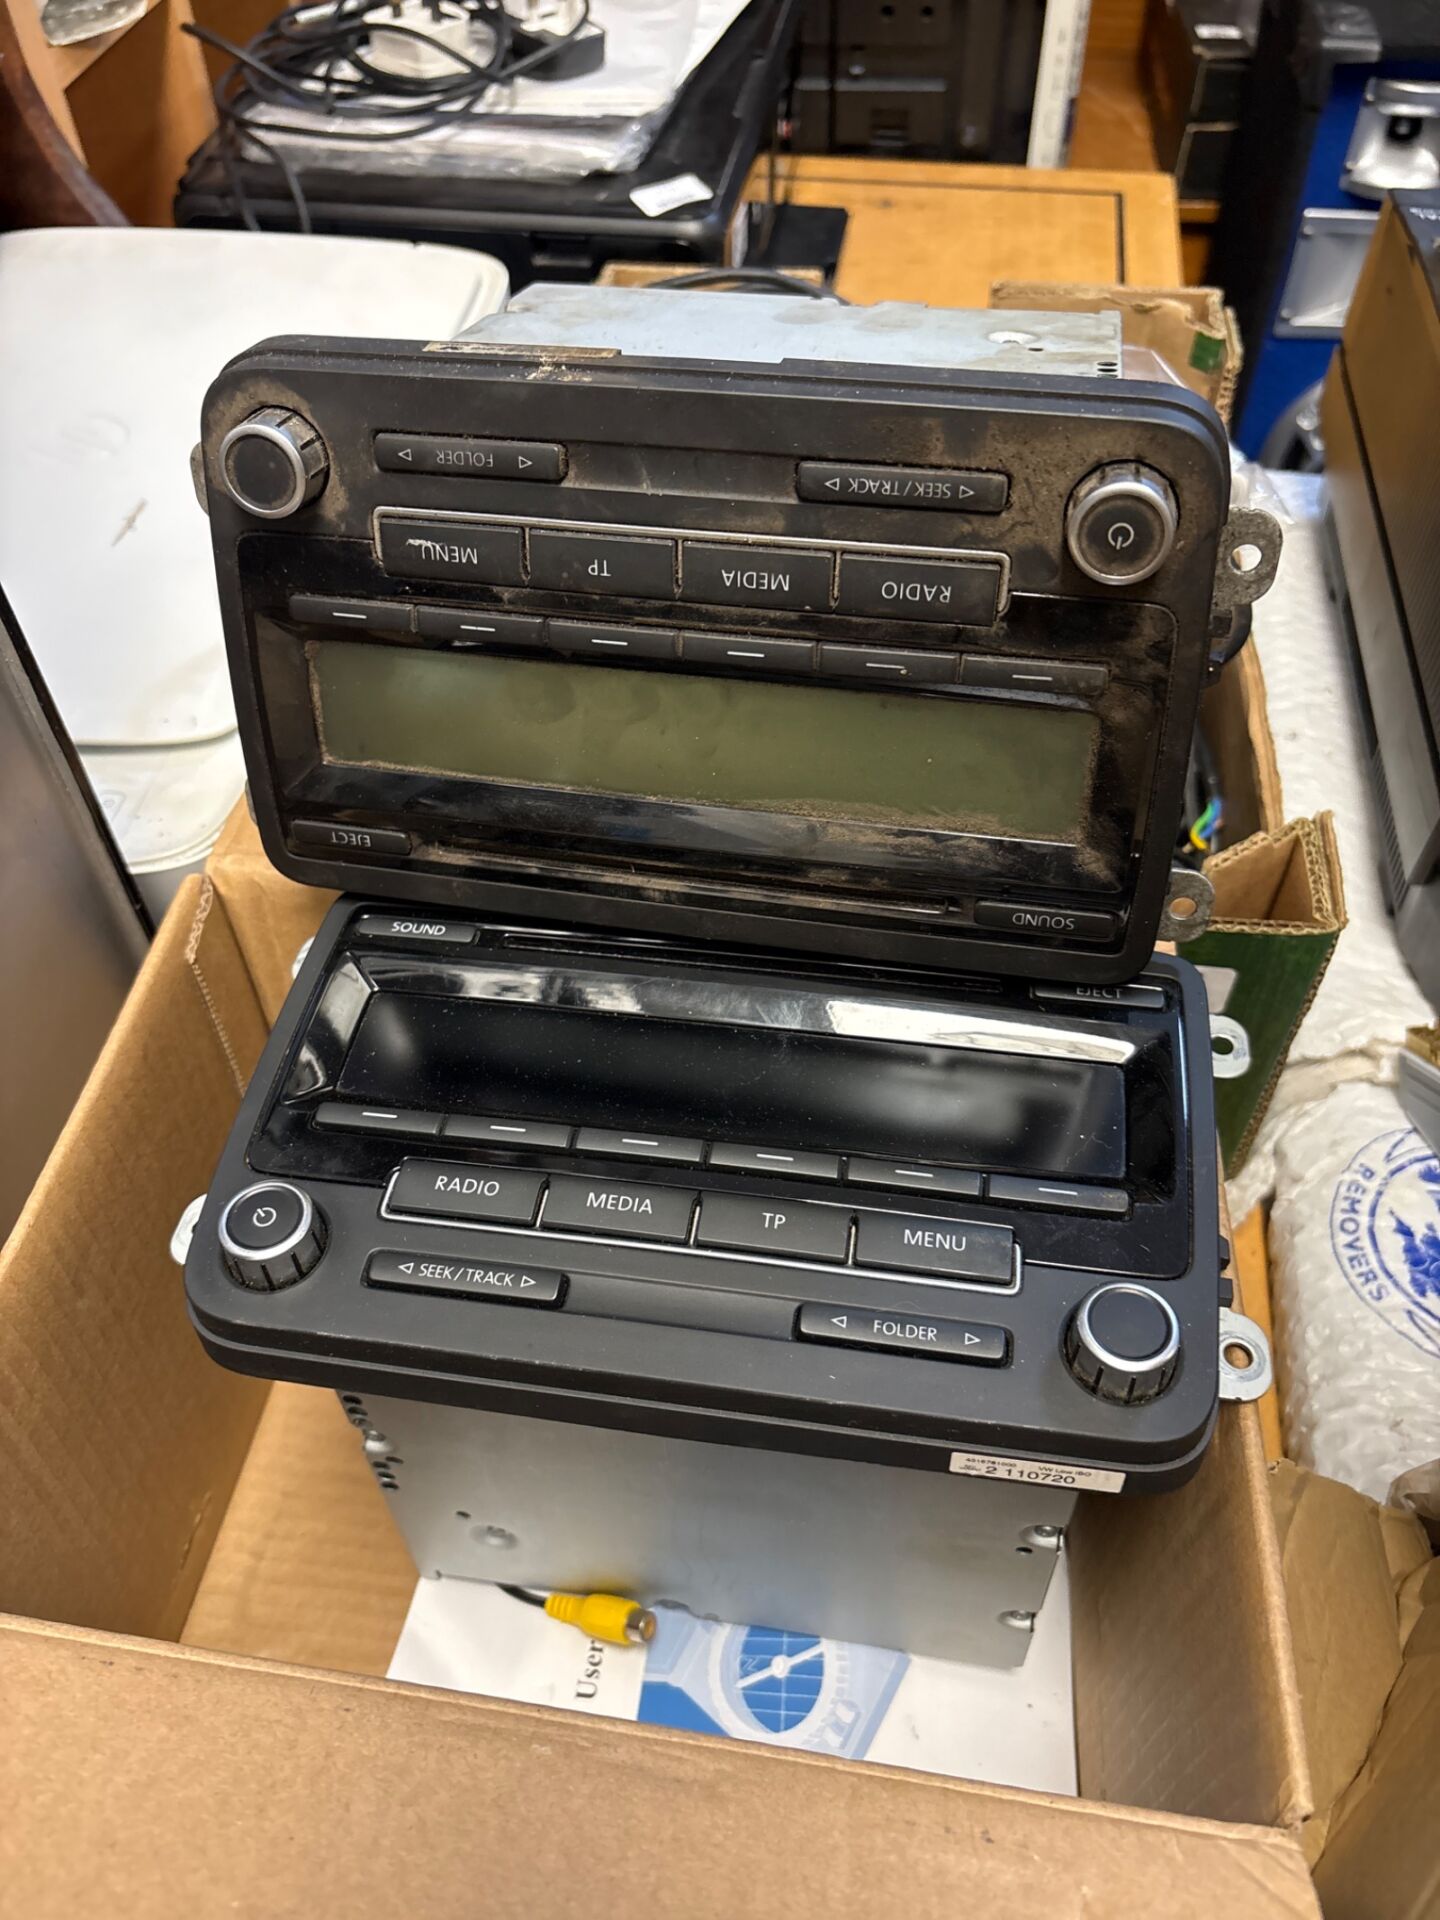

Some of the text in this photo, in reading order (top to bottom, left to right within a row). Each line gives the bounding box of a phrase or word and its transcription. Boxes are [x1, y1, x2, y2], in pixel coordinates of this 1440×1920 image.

[436, 450, 493, 468] FOLDER
[421, 544, 477, 565] MENU
[588, 559, 611, 577] TP
[721, 569, 790, 591] MEDIA
[881, 581, 951, 603] RADIO
[331, 831, 371, 847] EJECT
[391, 921, 446, 936] SOUND
[1012, 912, 1075, 930] SOUND
[1076, 986, 1123, 999] EJECT
[434, 1175, 500, 1196] RADIO
[586, 1192, 653, 1215] MEDIA
[762, 1212, 786, 1229] TP
[903, 1229, 967, 1251] MENU
[1339, 1162, 1390, 1302] REMOVERS
[873, 1319, 938, 1341] FOLDER
[985, 1465, 998, 1475] 2
[1005, 1468, 1076, 1484] 110720
[575, 1639, 605, 1699] User
